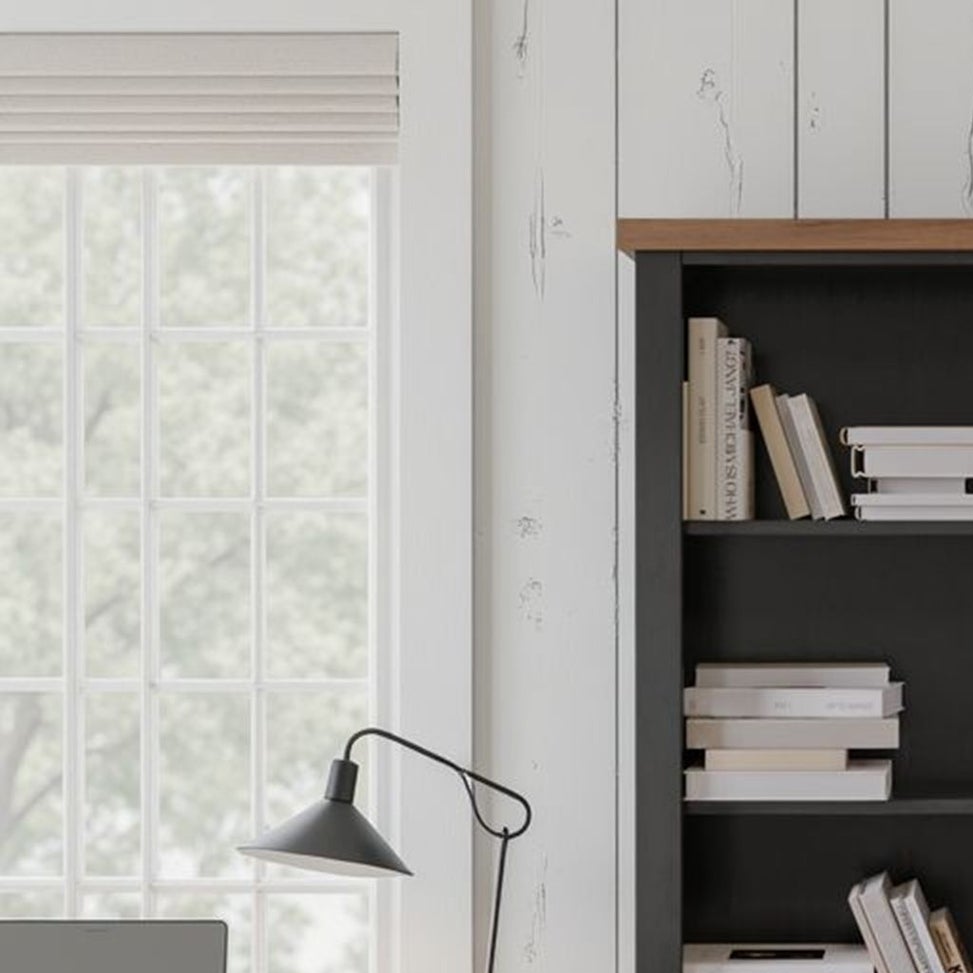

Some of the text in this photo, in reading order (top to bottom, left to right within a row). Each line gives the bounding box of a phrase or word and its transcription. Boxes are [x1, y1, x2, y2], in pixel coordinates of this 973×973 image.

[725, 399, 737, 464] MICHAEL
[725, 465, 737, 480] IS
[725, 482, 737, 520] WHO
